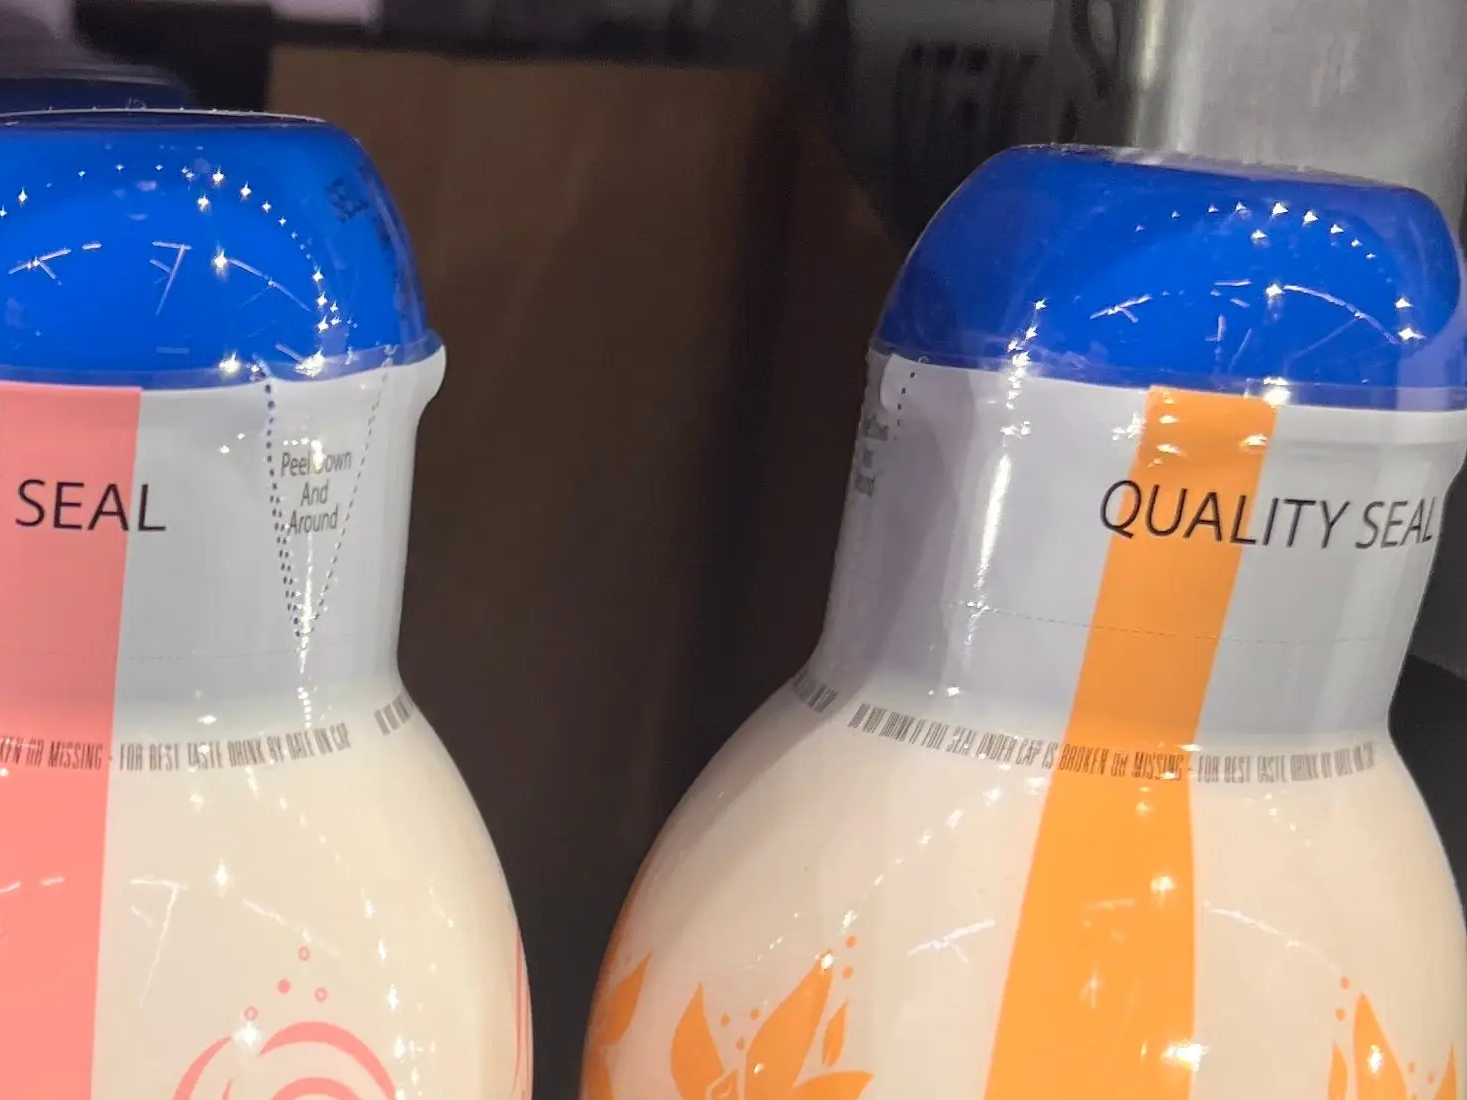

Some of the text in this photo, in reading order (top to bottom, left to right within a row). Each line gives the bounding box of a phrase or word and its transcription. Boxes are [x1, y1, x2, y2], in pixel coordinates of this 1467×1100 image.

[281, 450, 351, 477] Peel own
[15, 479, 166, 532] SEAL
[300, 479, 329, 506] And
[287, 502, 339, 535] Around
[1100, 479, 1437, 550] QUALITY SEAL
[47, 739, 104, 771] MISSING
[119, 742, 143, 771] FOR
[149, 742, 180, 772] BEST
